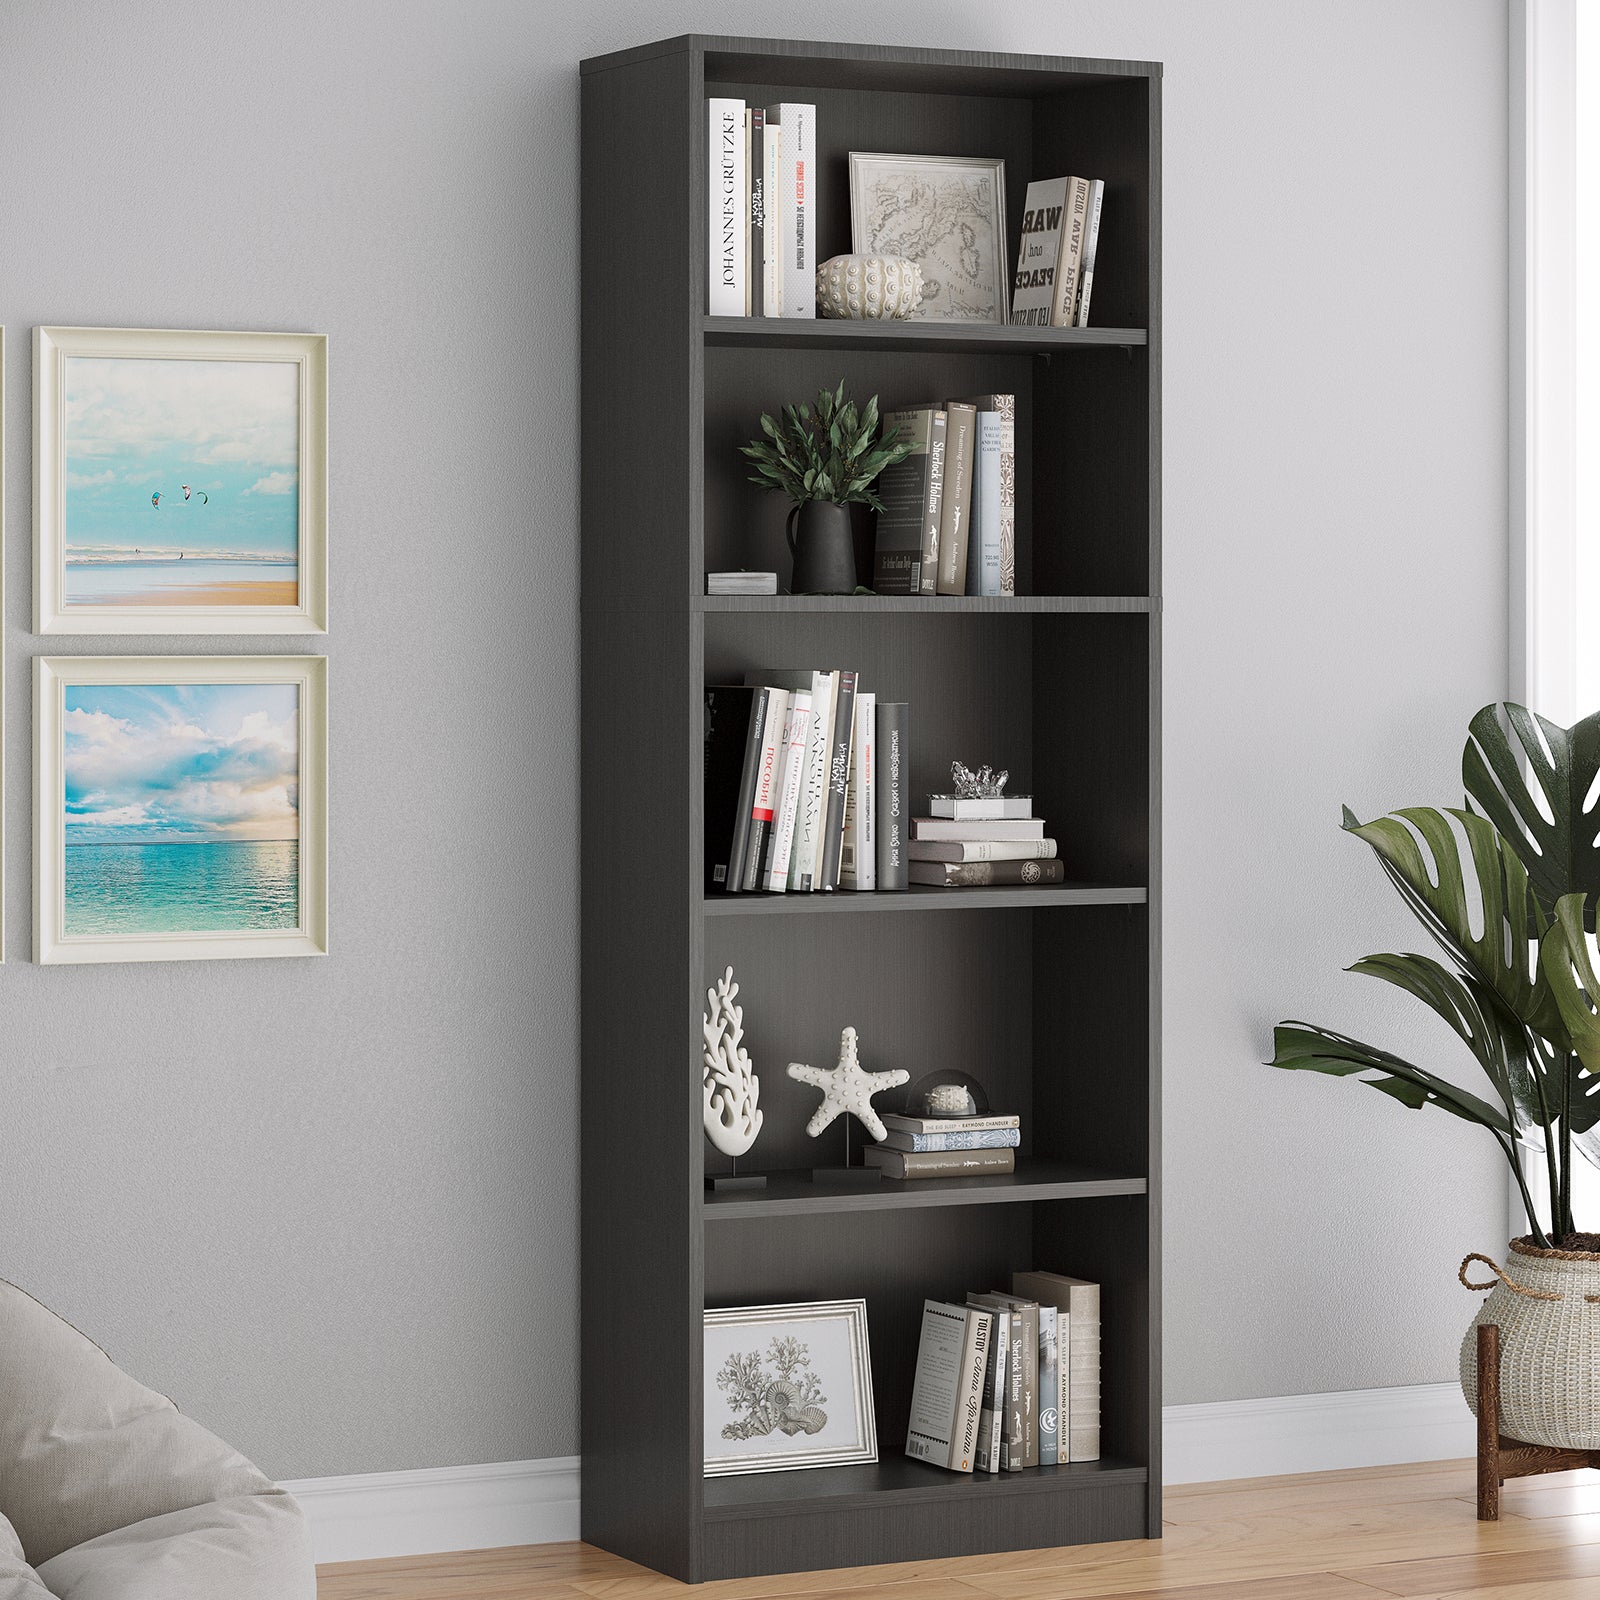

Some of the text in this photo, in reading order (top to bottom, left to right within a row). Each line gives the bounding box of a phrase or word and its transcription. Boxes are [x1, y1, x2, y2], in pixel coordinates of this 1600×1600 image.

[721, 111, 736, 289] JOHANNES GRÜTZKE
[956, 425, 967, 461] Dreaming
[928, 441, 945, 514] Sherlock Holmes
[955, 470, 963, 499] Sweden
[759, 747, 775, 805] ПОСОБИЕ
[804, 712, 821, 843] ДРАКОНАМИ
[890, 790, 900, 817] Сказки
[1023, 1321, 1031, 1354] Dreaming
[963, 1318, 988, 1455] TOLSTOY Anna Karenina
[1012, 1339, 1022, 1402] Sherlock Holmes
